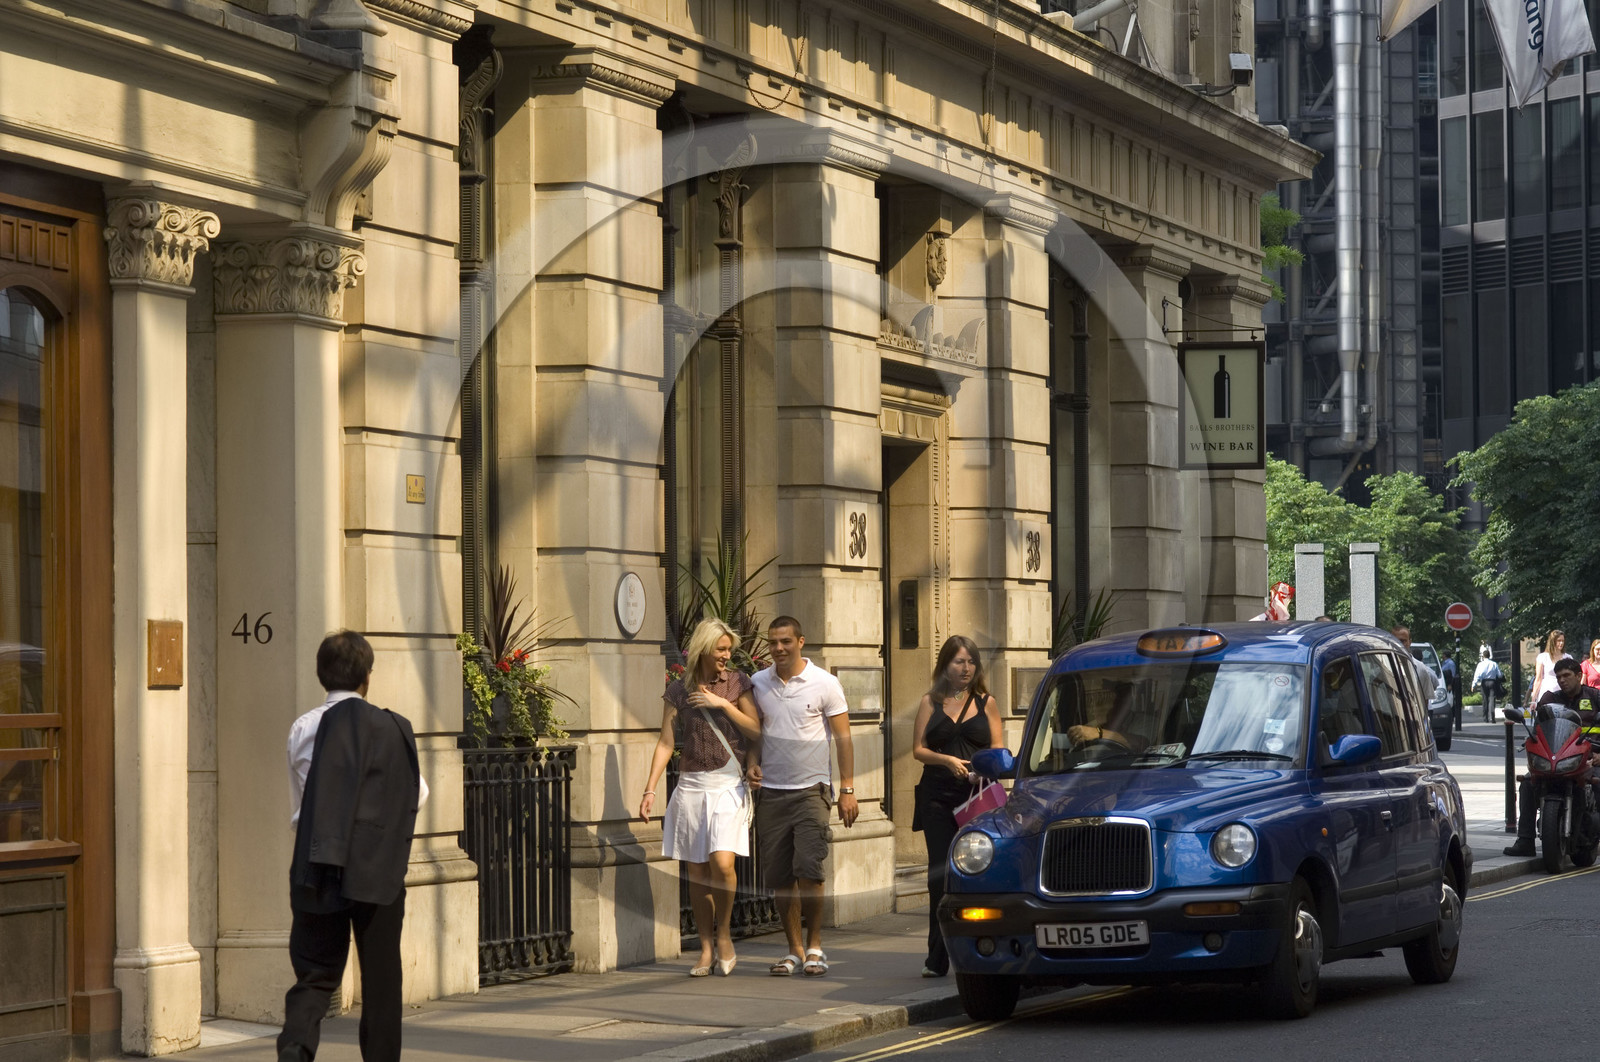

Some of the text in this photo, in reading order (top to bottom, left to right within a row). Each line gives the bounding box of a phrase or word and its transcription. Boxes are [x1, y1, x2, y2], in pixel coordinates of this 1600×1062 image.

[1189, 424, 1213, 432] BALLS
[1190, 442, 1255, 451] WINE BAR
[849, 511, 867, 559] 38
[1025, 530, 1041, 573] 38
[231, 611, 273, 645] 46
[1043, 923, 1141, 946] LR05 GDE
